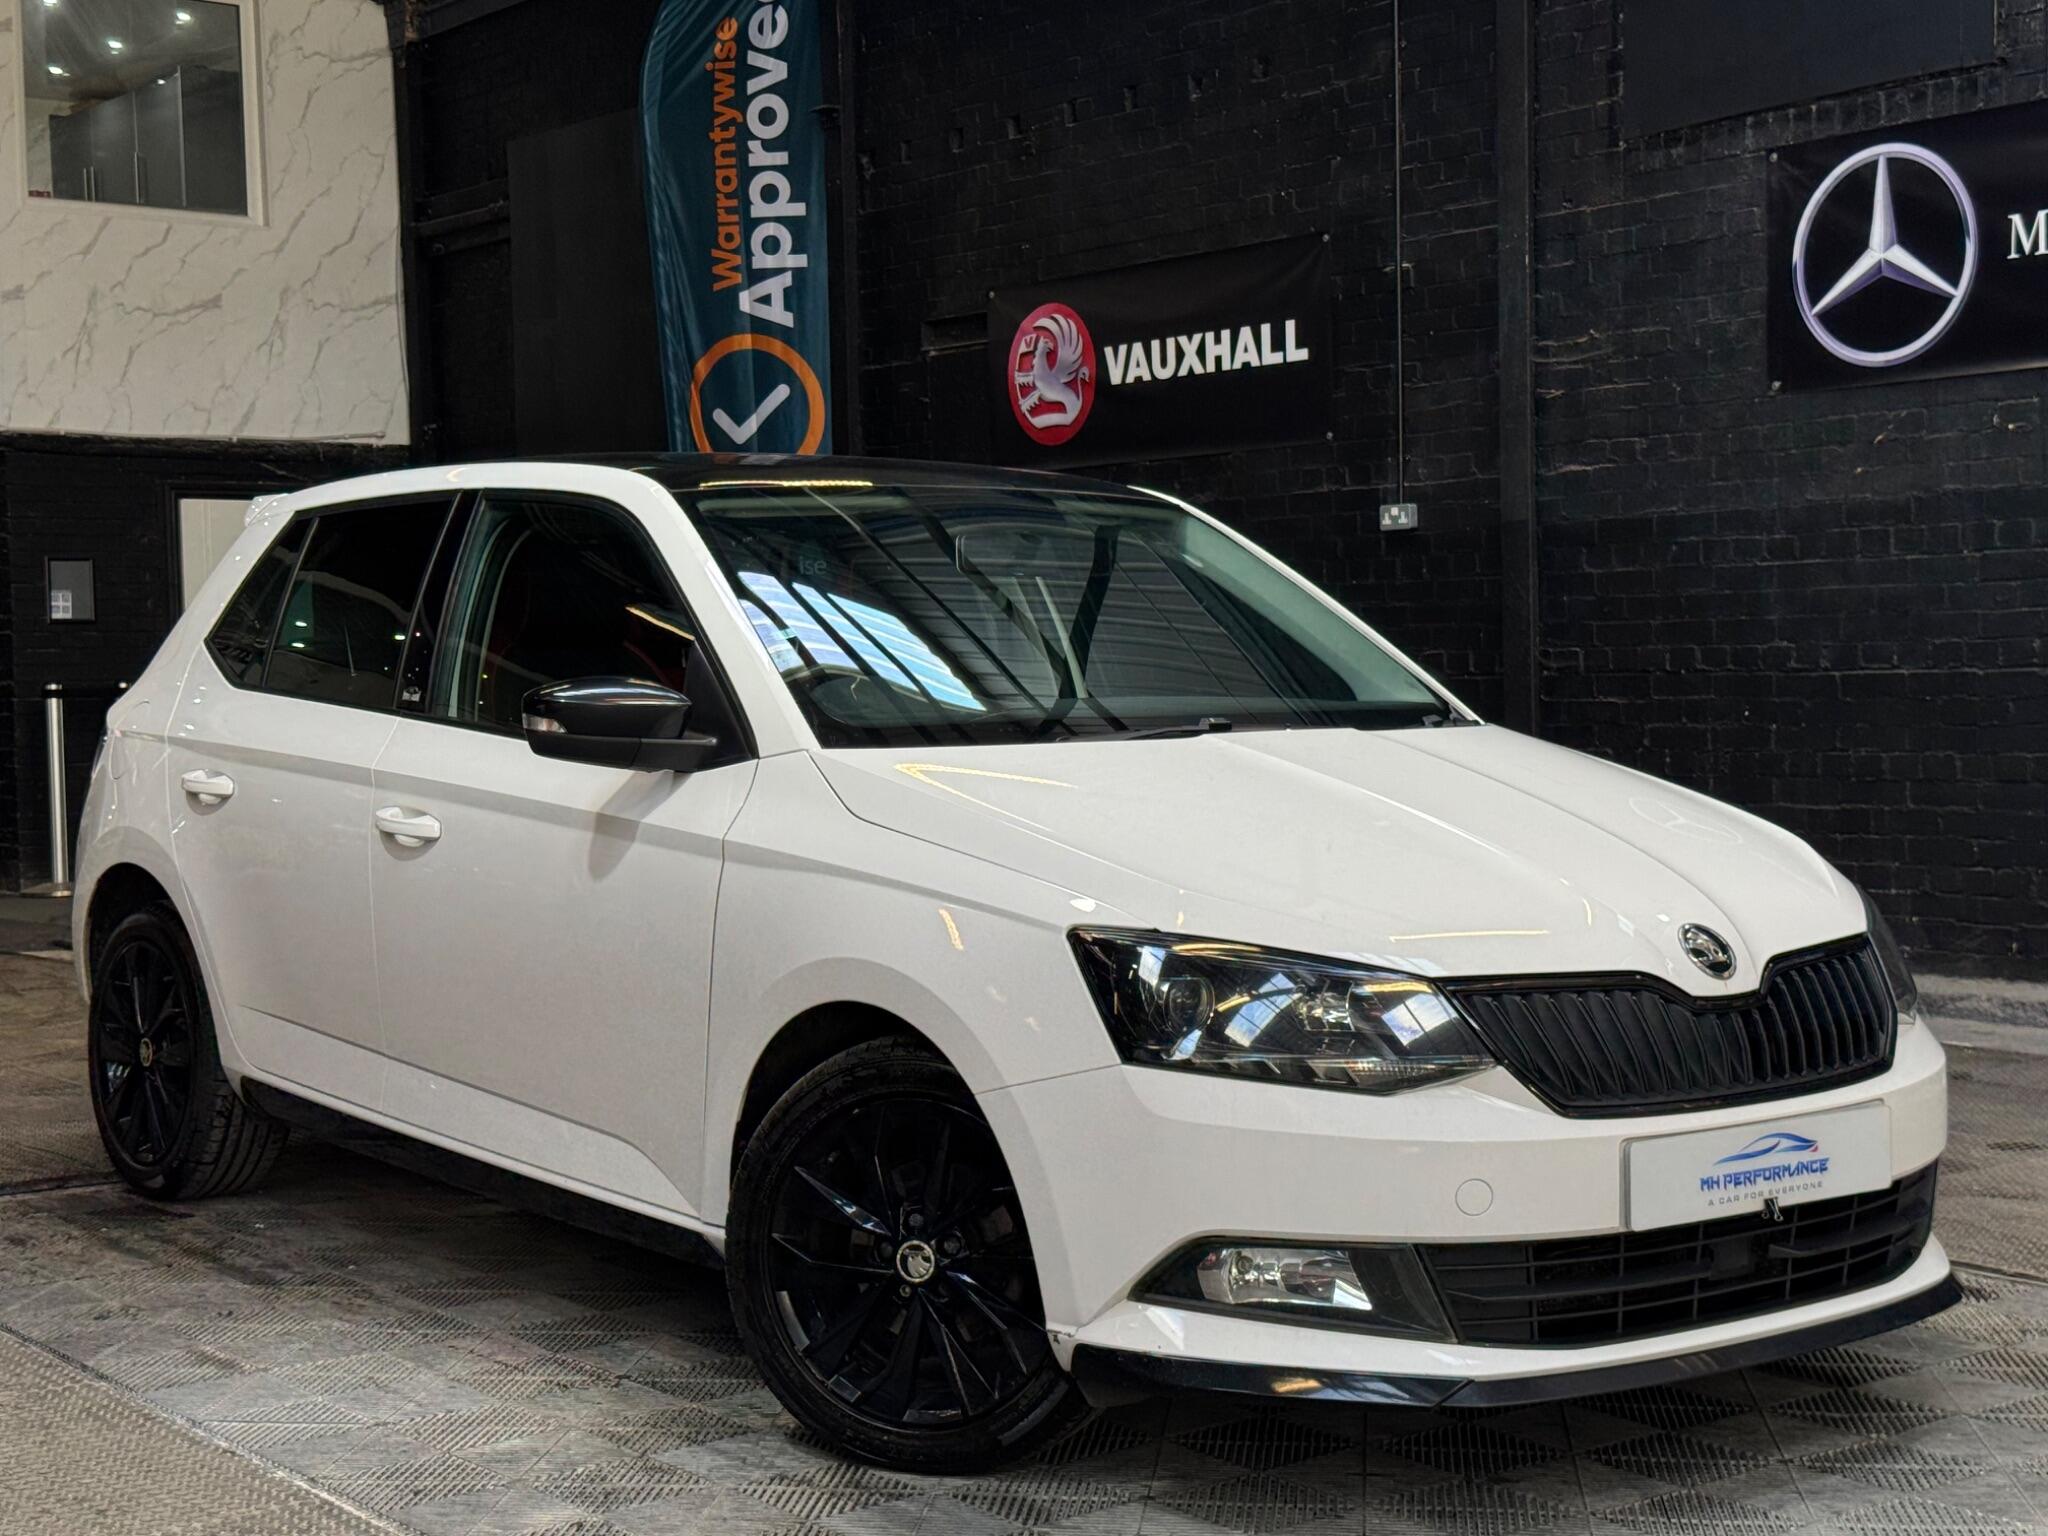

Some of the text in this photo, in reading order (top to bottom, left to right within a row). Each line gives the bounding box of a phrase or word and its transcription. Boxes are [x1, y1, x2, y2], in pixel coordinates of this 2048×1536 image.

[705, 16, 743, 291] Warrantywise
[739, 0, 808, 328] Approve
[1103, 319, 1309, 385] VAUXHALL
[1700, 1157, 1830, 1192] MH PERFORMANCE
[1707, 1180, 1823, 1207] A CAR FOR EVERYONE
